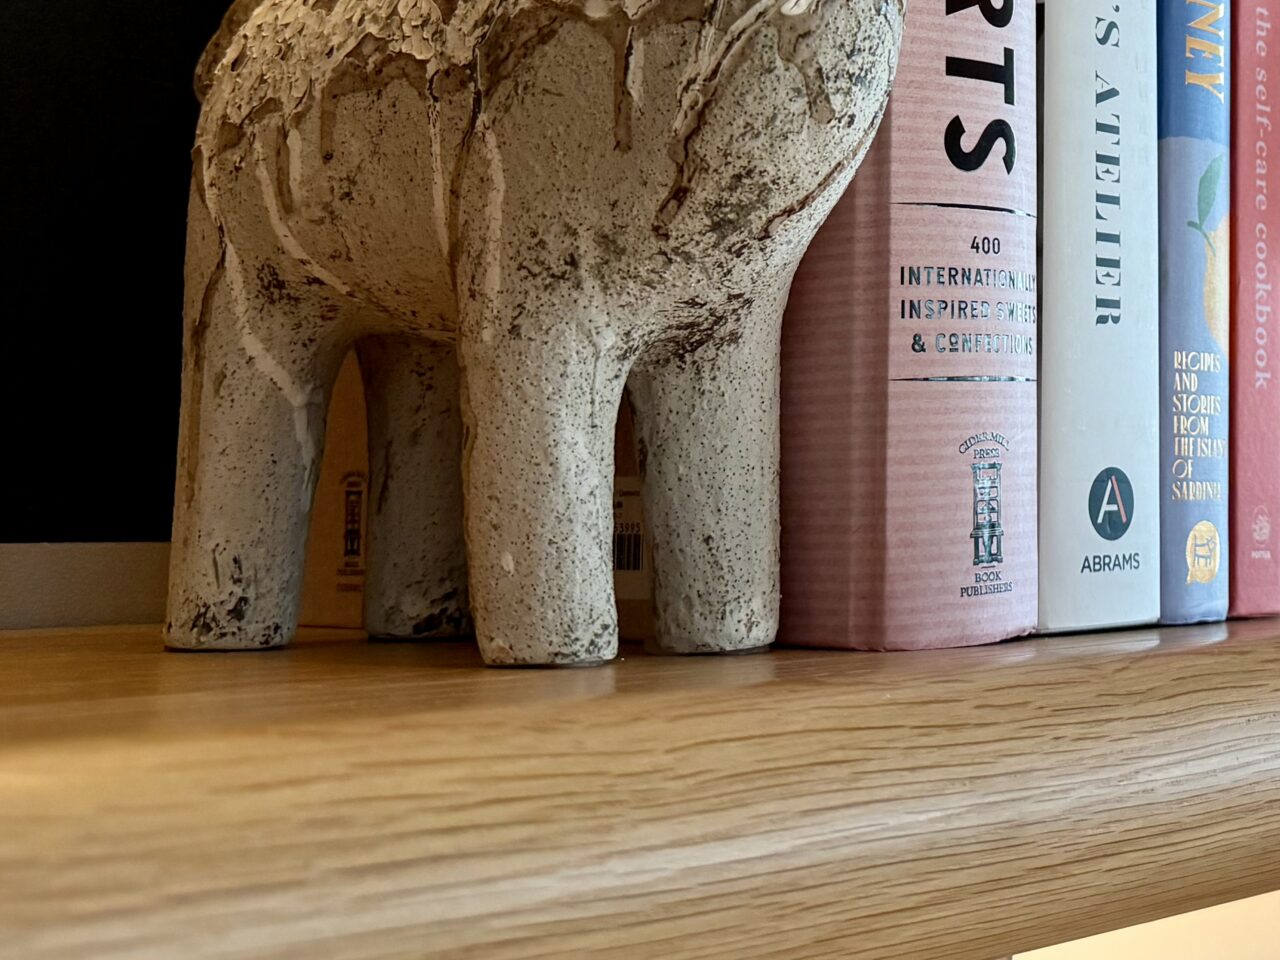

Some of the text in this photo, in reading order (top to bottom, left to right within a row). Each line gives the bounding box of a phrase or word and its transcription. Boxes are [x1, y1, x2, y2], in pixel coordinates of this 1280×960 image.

[1095, 70, 1121, 325] ATELIER
[1255, 6, 1274, 390] the self-care cookbook
[970, 236, 1001, 255] 400
[900, 266, 1035, 291] INTERNATIONALLY
[900, 299, 1036, 324] INSPIRED SWEETS
[911, 332, 1033, 356] & CONFECTIONS
[1174, 351, 1221, 373] RECIPES
[1173, 372, 1198, 393] AND
[1172, 393, 1222, 415] STORIES
[1173, 415, 1209, 436] FROM
[973, 448, 1000, 459] PRESS
[1173, 436, 1195, 457] THE
[1172, 458, 1194, 479] OF
[1080, 552, 1140, 573] ABRAMS
[975, 570, 1002, 583] BOOK
[960, 581, 1013, 598] PUBLISHERS
